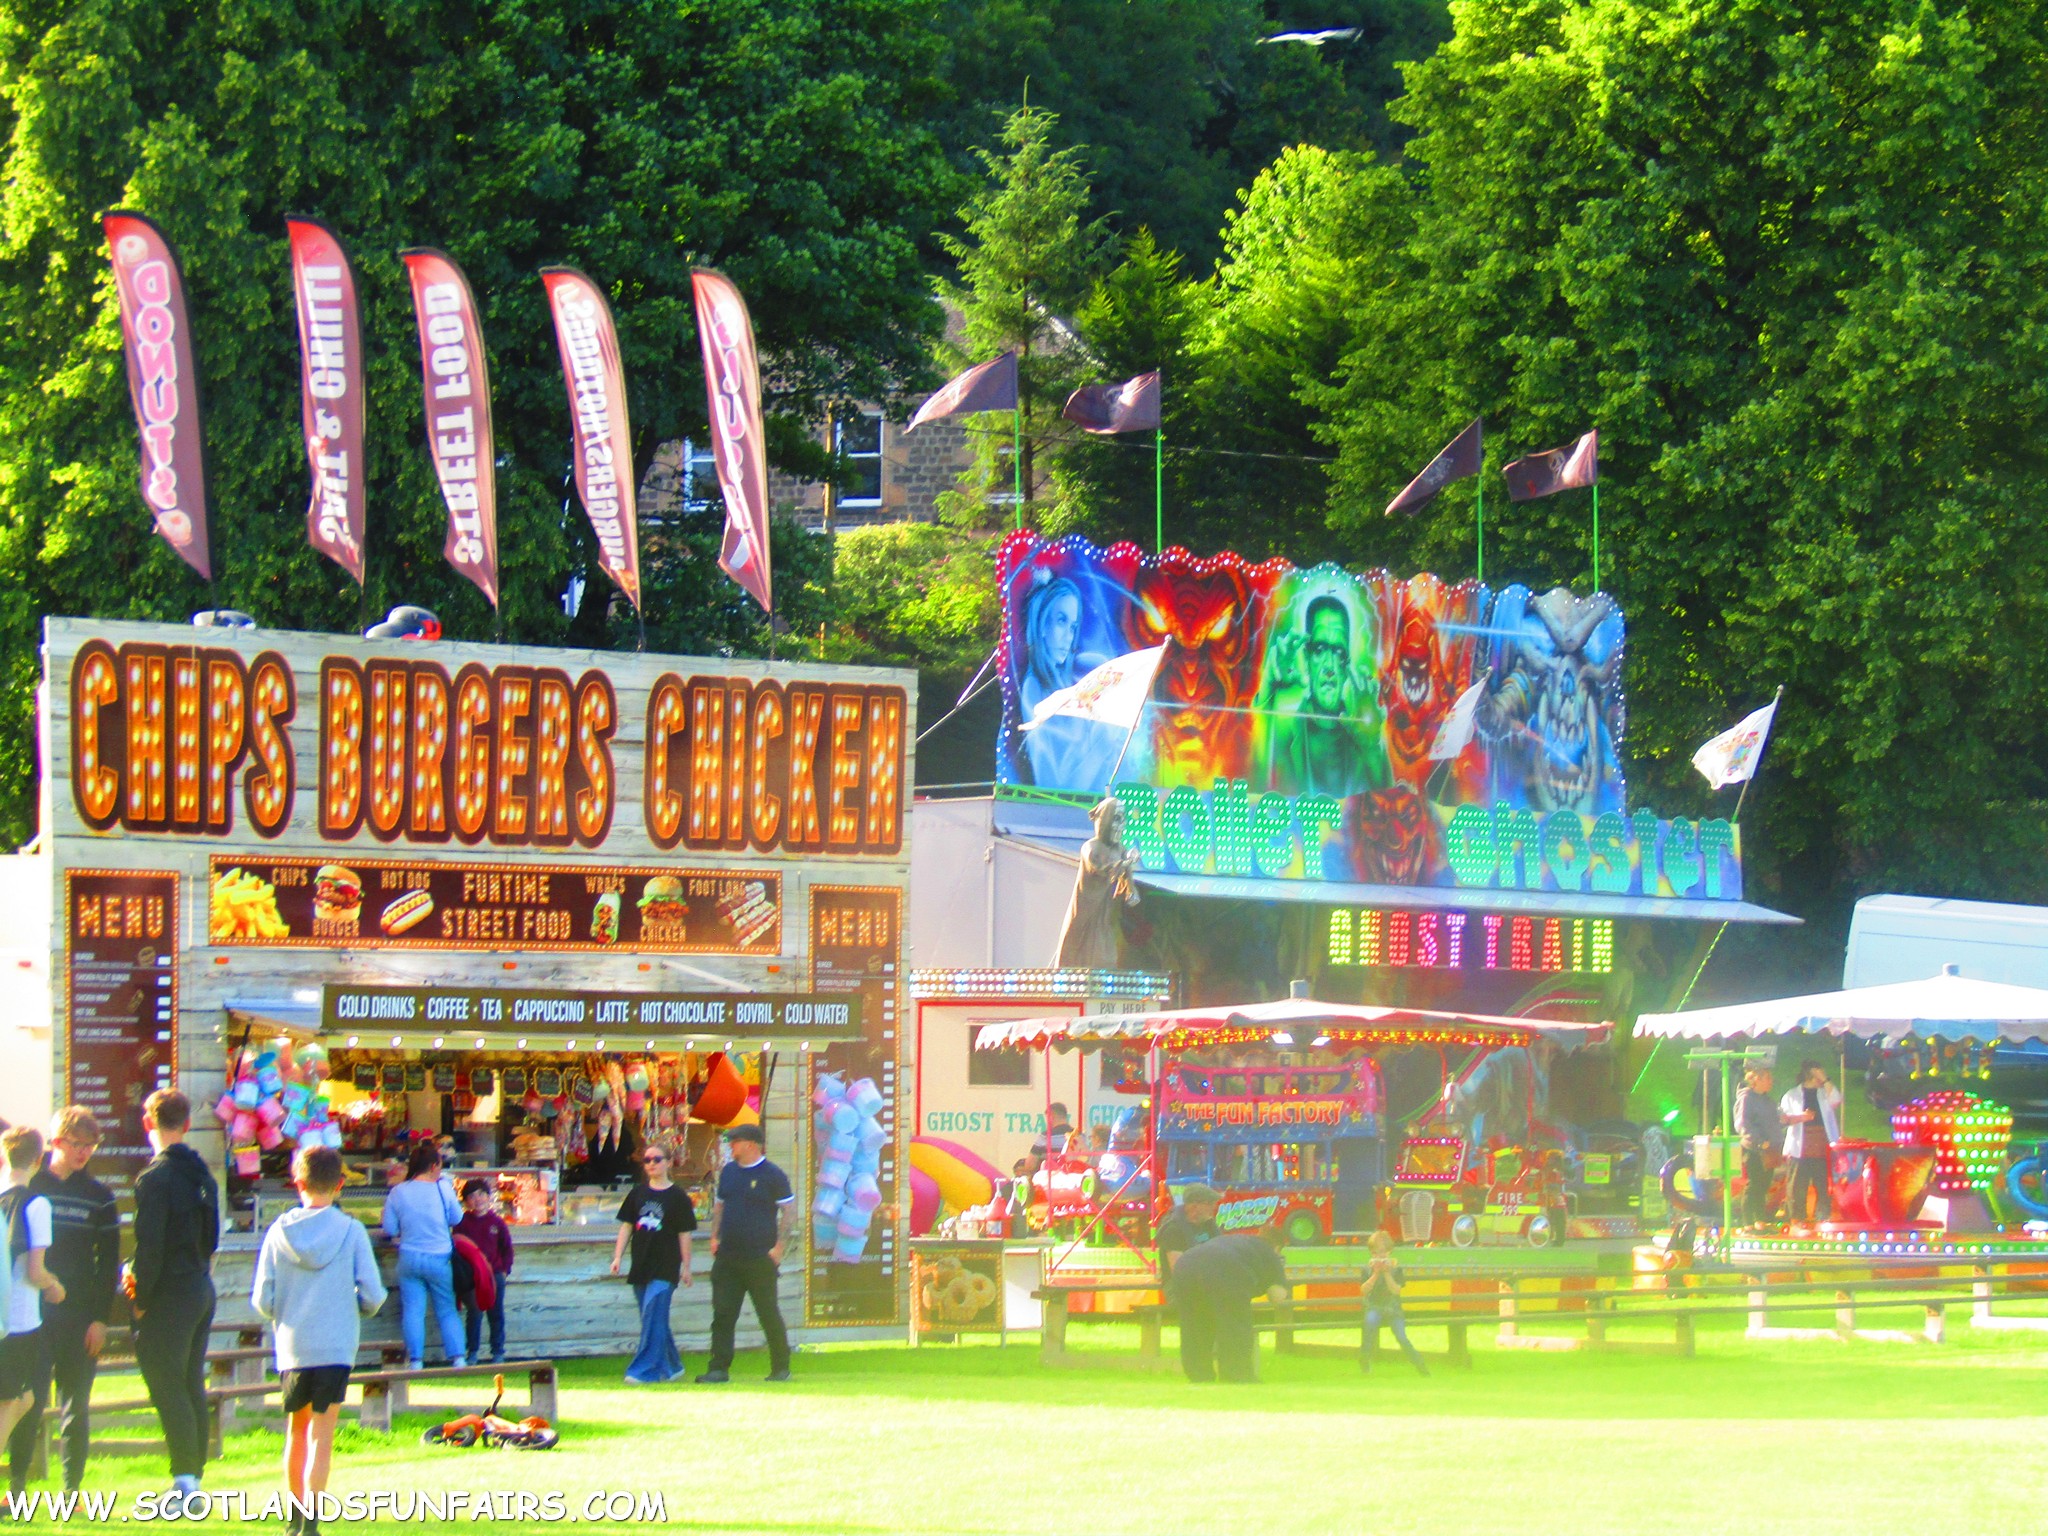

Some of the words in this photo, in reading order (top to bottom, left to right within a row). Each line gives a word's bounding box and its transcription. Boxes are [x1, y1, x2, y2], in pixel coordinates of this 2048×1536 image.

[78, 650, 289, 829] CHIPS
[325, 667, 611, 839] BURGERS
[650, 684, 901, 845] CHICKEN
[271, 867, 309, 887] CHIPS
[381, 871, 404, 889] HOT
[406, 871, 431, 891] DOG
[463, 871, 551, 904] FUNTIME
[584, 875, 626, 895] WRAPS
[688, 879, 716, 897] FOOT
[719, 879, 746, 899] LONG
[78, 894, 164, 938] MENU
[441, 908, 517, 939] STREET
[523, 910, 572, 940] FOOD
[818, 908, 889, 948] MENU
[313, 919, 361, 938] BURGER
[639, 925, 687, 943] CHICKEN
[1483, 915, 1613, 973] TRAIN
[338, 995, 369, 1018] COLD
[371, 995, 415, 1019] DRINKS
[427, 997, 469, 1021] COFFEE
[481, 998, 502, 1021] TEA
[514, 999, 585, 1022] CAPPUCCINO
[597, 1000, 630, 1023] LATTE
[640, 1001, 662, 1023] HOT
[664, 1001, 726, 1024] CHOCOLATE
[736, 1002, 775, 1025] BOVRIL
[785, 1003, 812, 1025] COLD
[814, 1003, 849, 1025] WATER
[1100, 1002, 1117, 1015] PAY
[927, 1111, 994, 1132] GHOST
[1184, 1102, 1216, 1121] THE
[1216, 1101, 1254, 1128] FUN
[1258, 1100, 1344, 1127] FACTORY
[1497, 1192, 1523, 1204] FIRE
[1215, 1195, 1280, 1228] HAPPY
